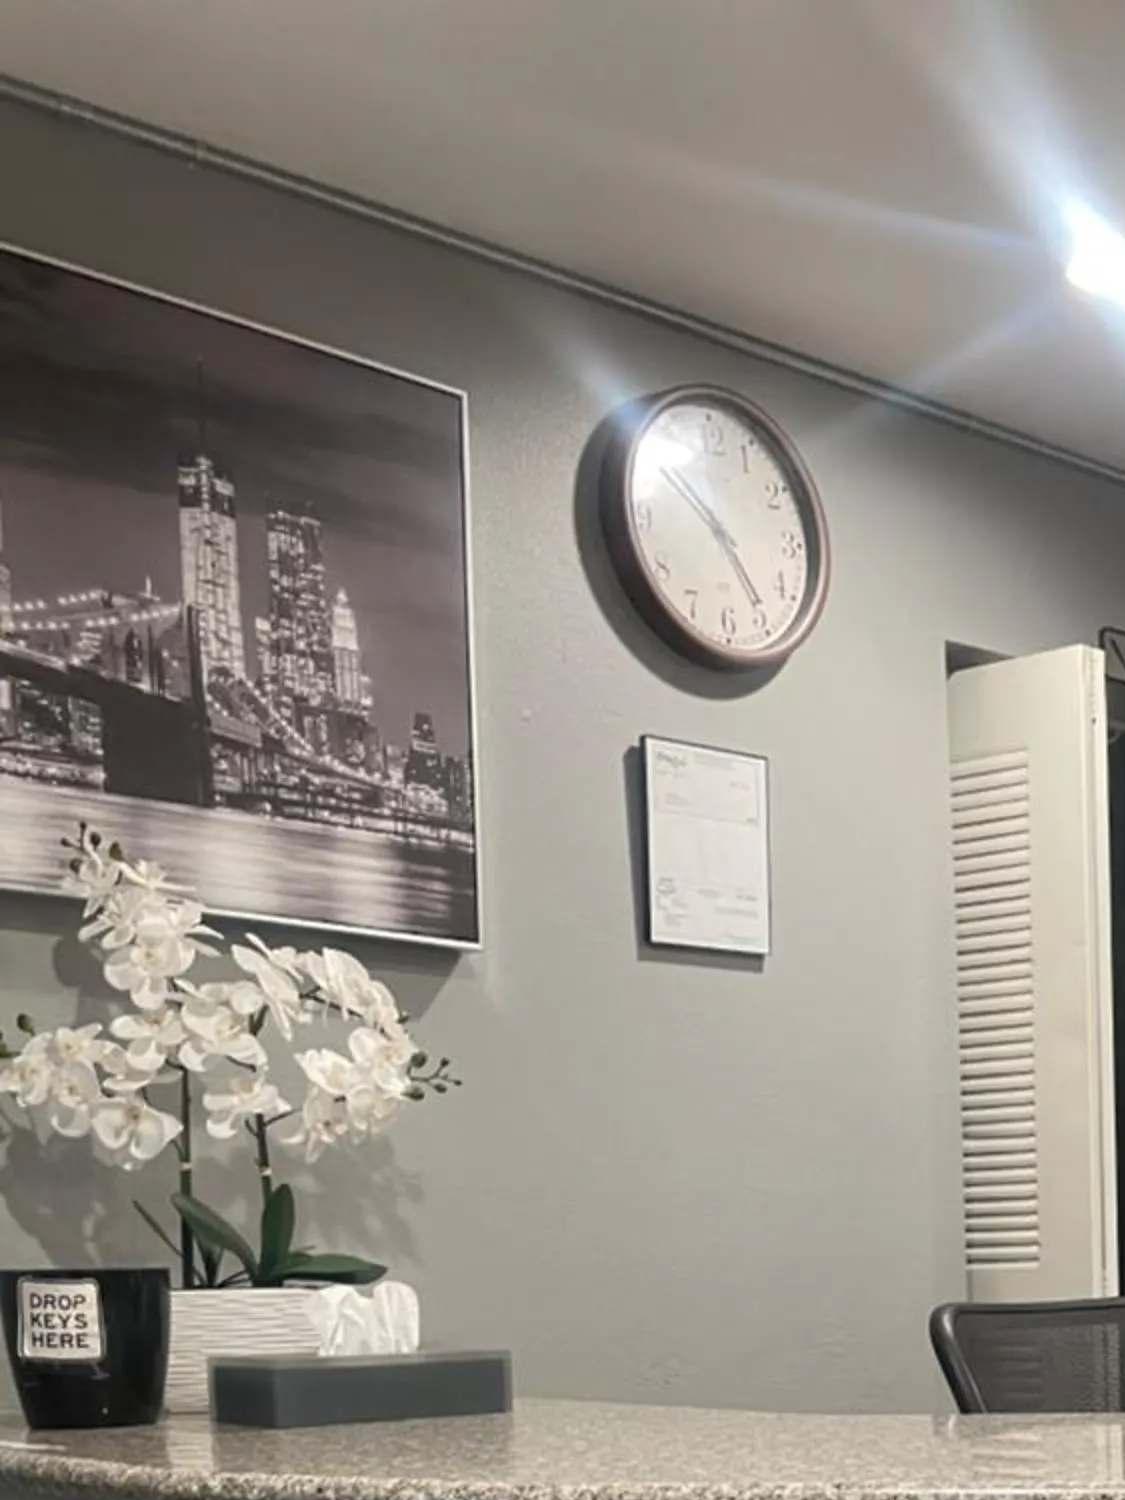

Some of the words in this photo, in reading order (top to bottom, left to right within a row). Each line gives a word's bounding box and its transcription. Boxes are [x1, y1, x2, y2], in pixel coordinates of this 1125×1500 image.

[704, 425, 725, 457] 12
[738, 445, 751, 474] 1
[764, 481, 781, 511] 2
[638, 505, 653, 532] 9
[781, 531, 797, 560] 3
[654, 553, 671, 582] 8
[773, 570, 786, 600] 4
[684, 589, 698, 620] 7
[721, 607, 737, 638] 6
[29, 1293, 87, 1310] DROP
[30, 1312, 88, 1329] KEYS
[32, 1332, 89, 1348] HERE
